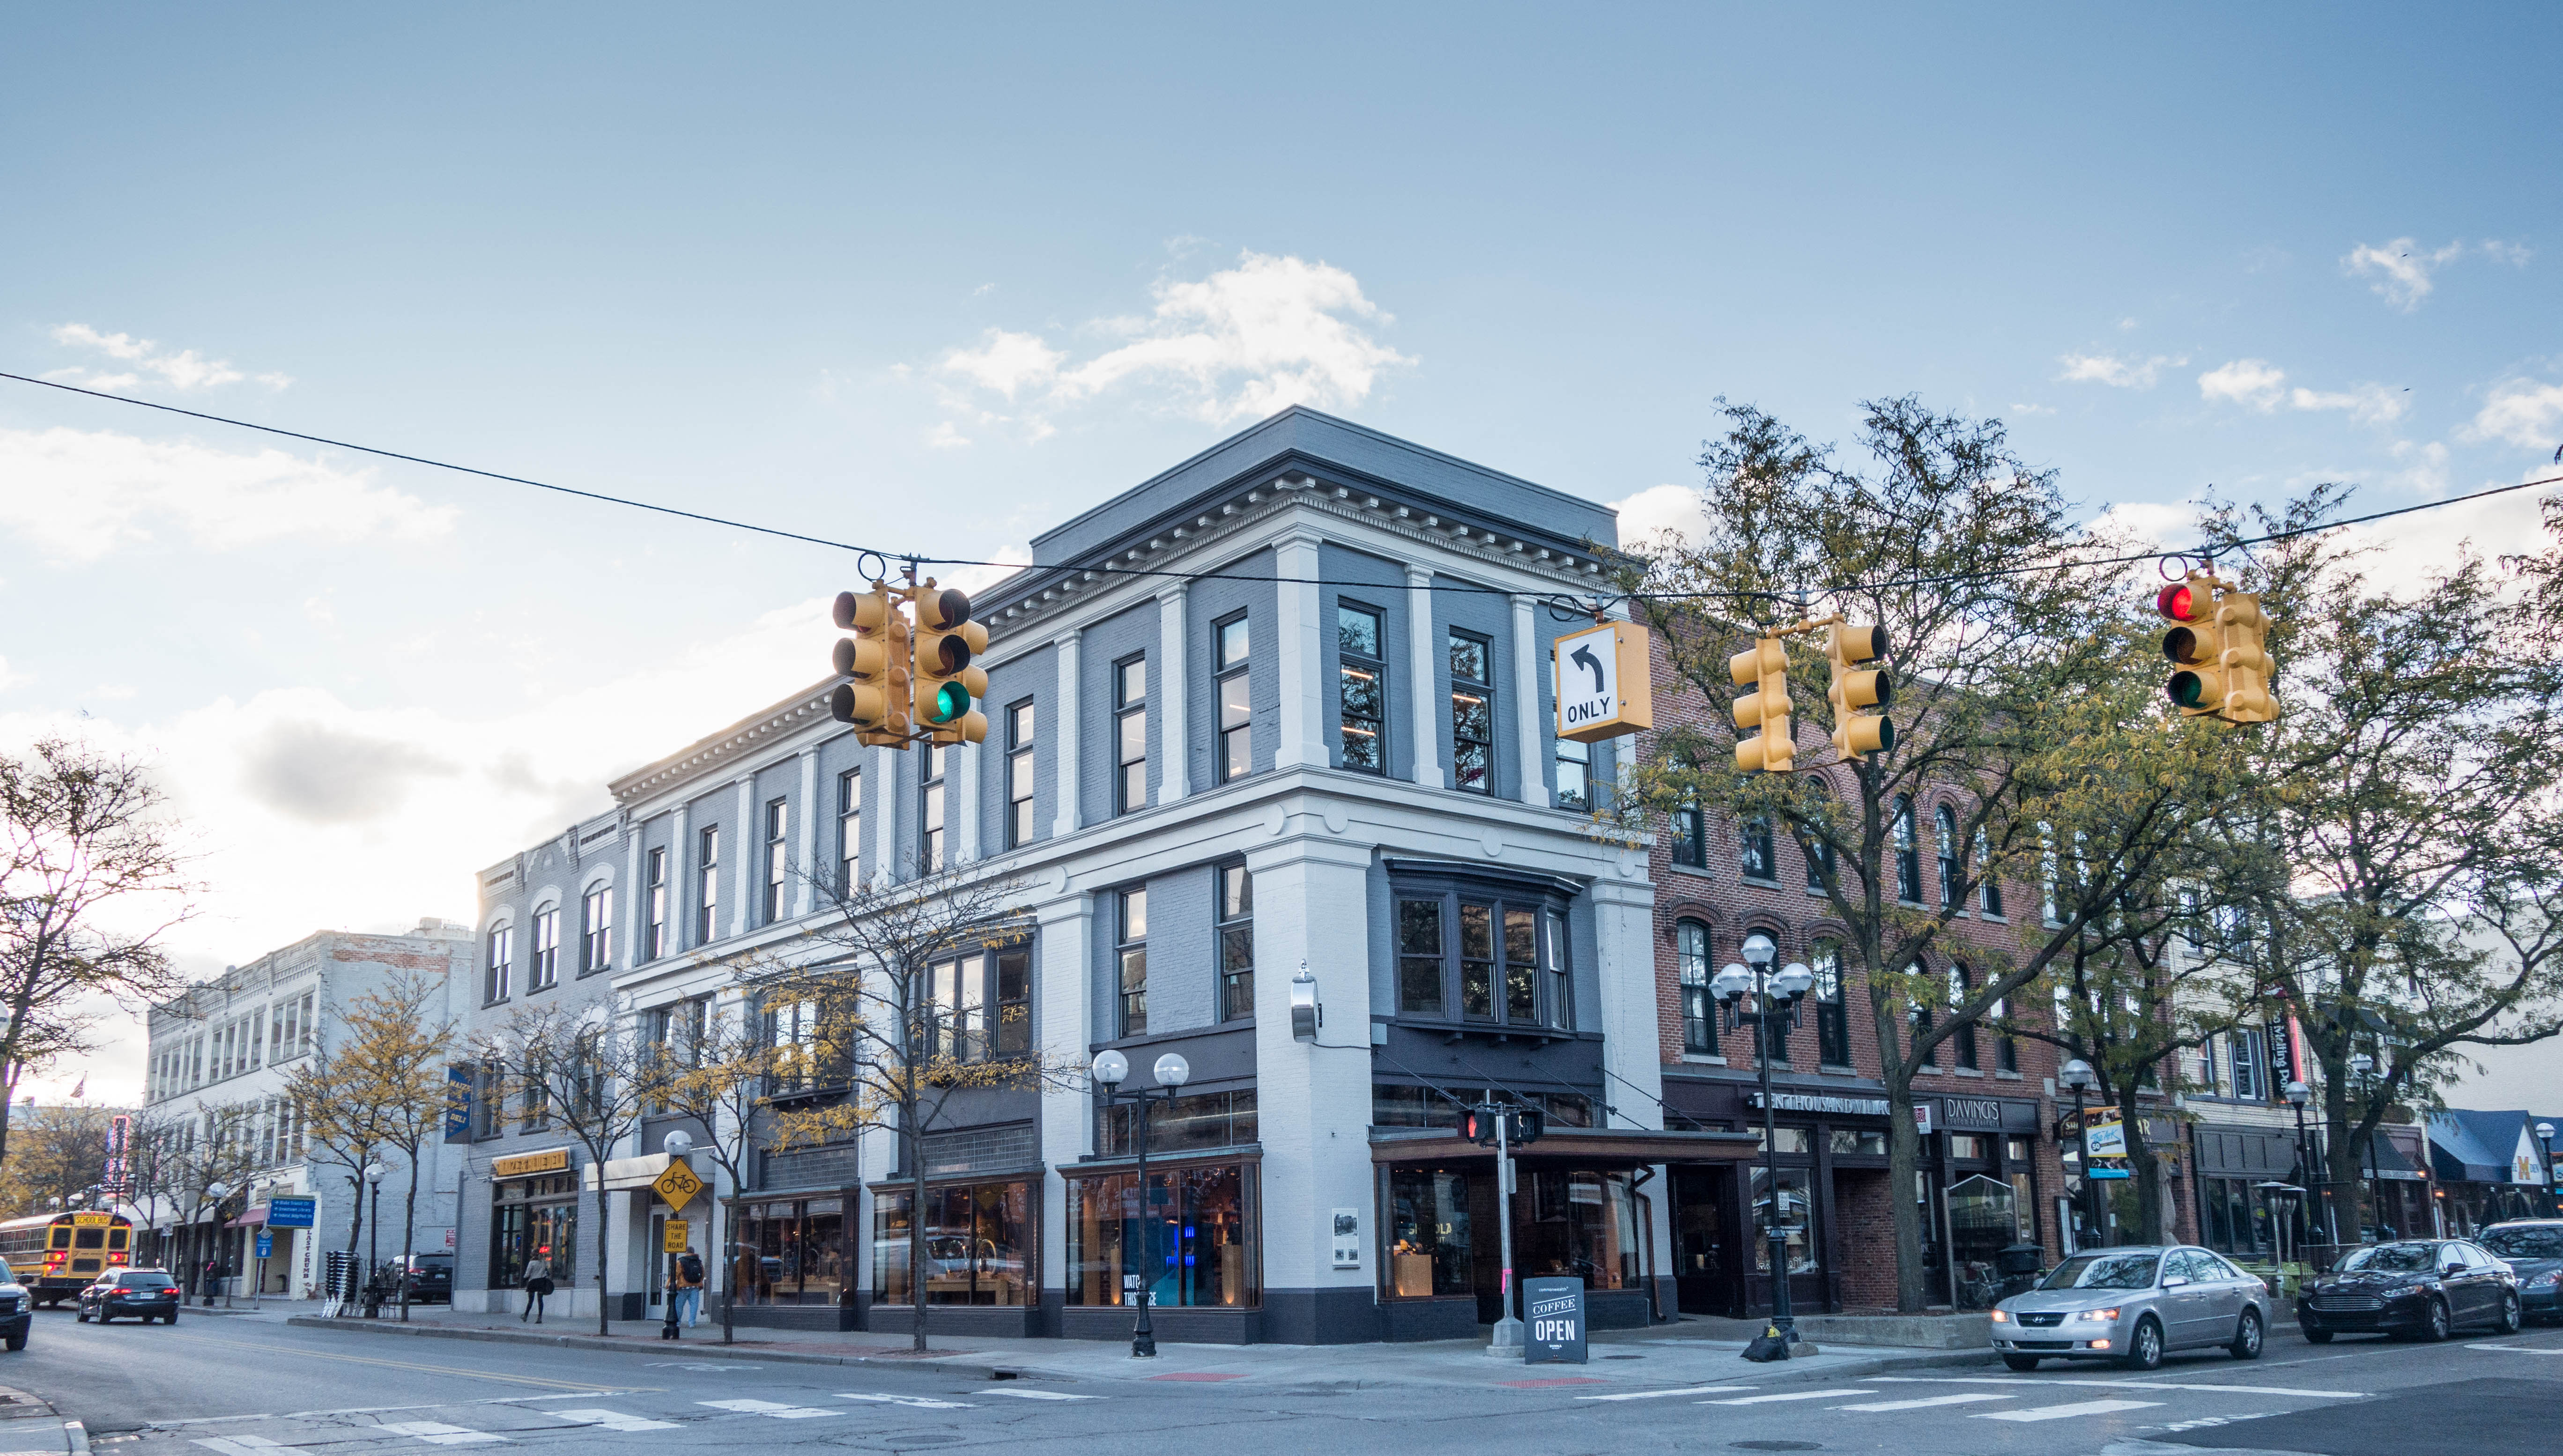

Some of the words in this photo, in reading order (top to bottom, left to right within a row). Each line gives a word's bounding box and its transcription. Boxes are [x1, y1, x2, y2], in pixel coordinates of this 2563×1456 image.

[1568, 696, 1610, 723] ONLY
[2274, 1026, 2287, 1068] Melting
[1784, 1094, 1852, 1114] THOUSAND
[1948, 1099, 1999, 1120] DAVINCI'S
[450, 1113, 467, 1123] DELI
[2518, 1156, 2530, 1180] M
[1124, 1274, 1141, 1289] WATC
[1124, 1292, 1137, 1306] THIS
[1533, 1298, 1575, 1315] COFFEE
[1535, 1320, 1575, 1341] OPEN
